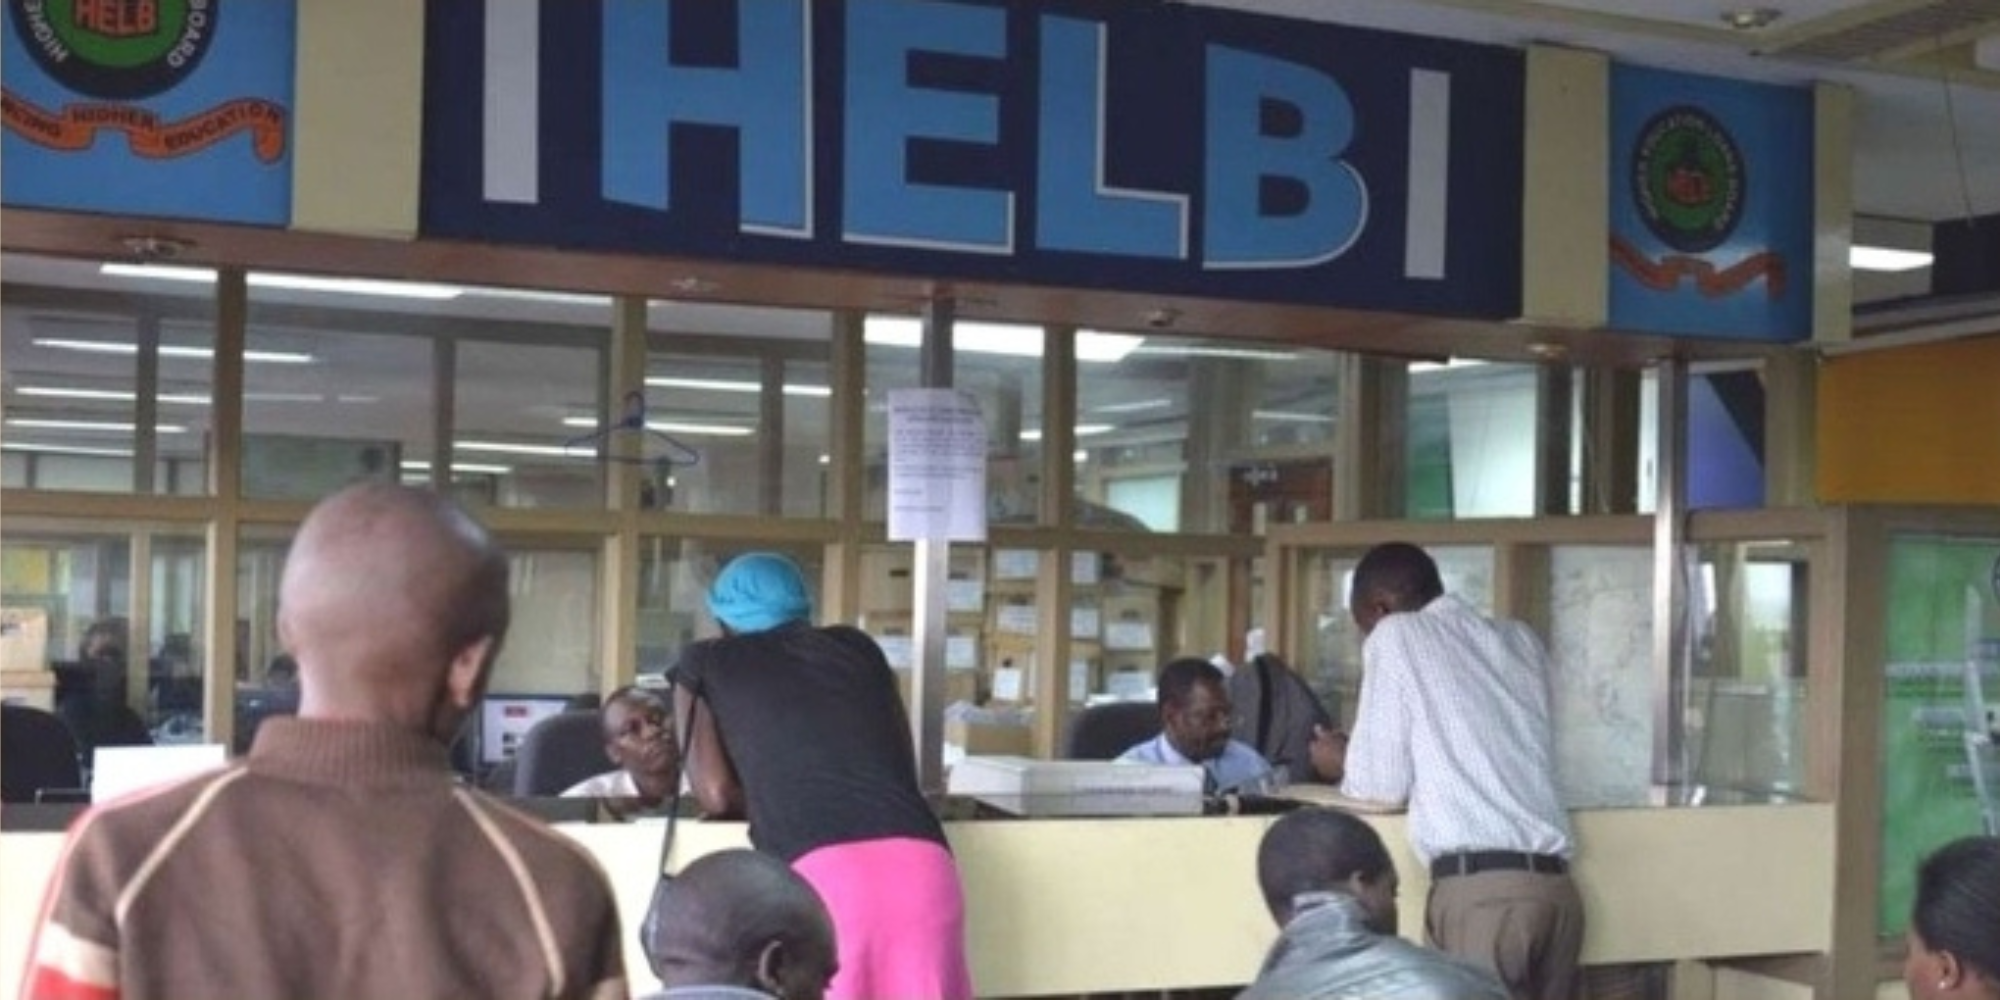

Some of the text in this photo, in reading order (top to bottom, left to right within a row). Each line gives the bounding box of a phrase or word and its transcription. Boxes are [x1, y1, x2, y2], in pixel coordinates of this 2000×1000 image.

[75, 0, 158, 36] HELB
[163, 103, 283, 149] EDUCATION
[602, 0, 1369, 270] HELB
